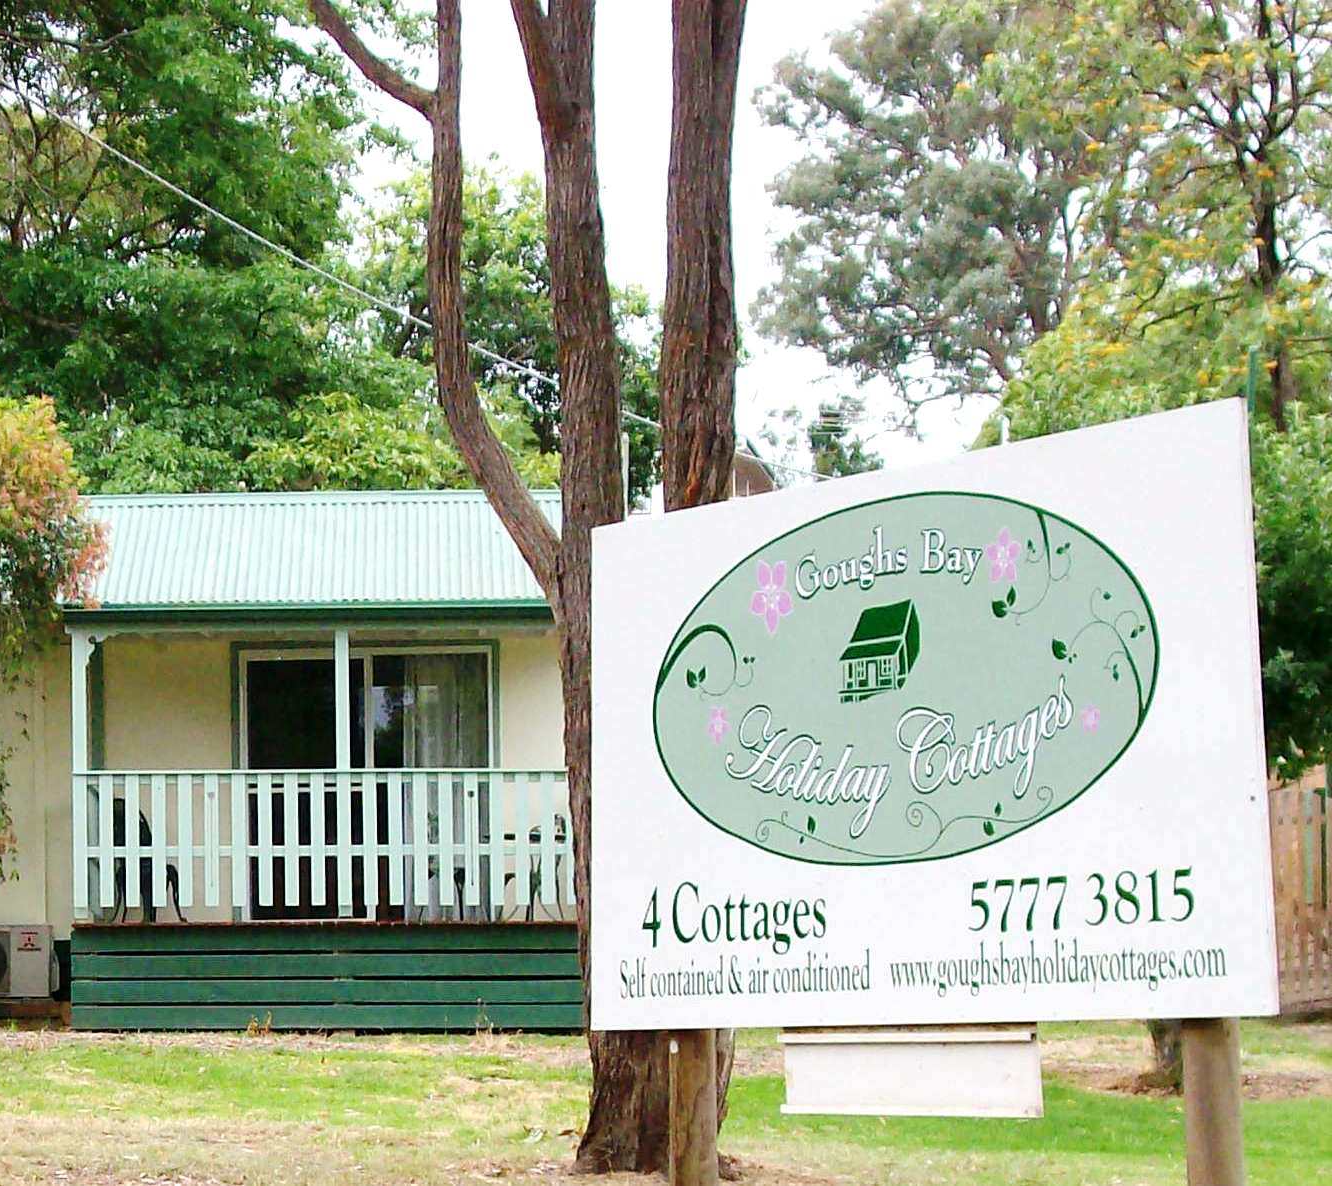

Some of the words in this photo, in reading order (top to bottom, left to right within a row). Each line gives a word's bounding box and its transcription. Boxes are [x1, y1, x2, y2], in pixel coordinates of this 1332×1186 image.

[794, 525, 909, 597] Goughs
[921, 527, 984, 584] Bay
[725, 704, 891, 837] Holiday
[895, 675, 1075, 798] Cottages
[642, 886, 661, 948] 4
[671, 883, 827, 955] Cottages
[969, 876, 1067, 933] 5777
[1085, 866, 1195, 926] 3815
[619, 957, 647, 999] Self
[650, 955, 724, 998] contained
[727, 956, 745, 995] &
[748, 954, 769, 993] air
[771, 948, 871, 994] conditioned
[889, 939, 1228, 996] www.goughsbayholidaycottages.com
